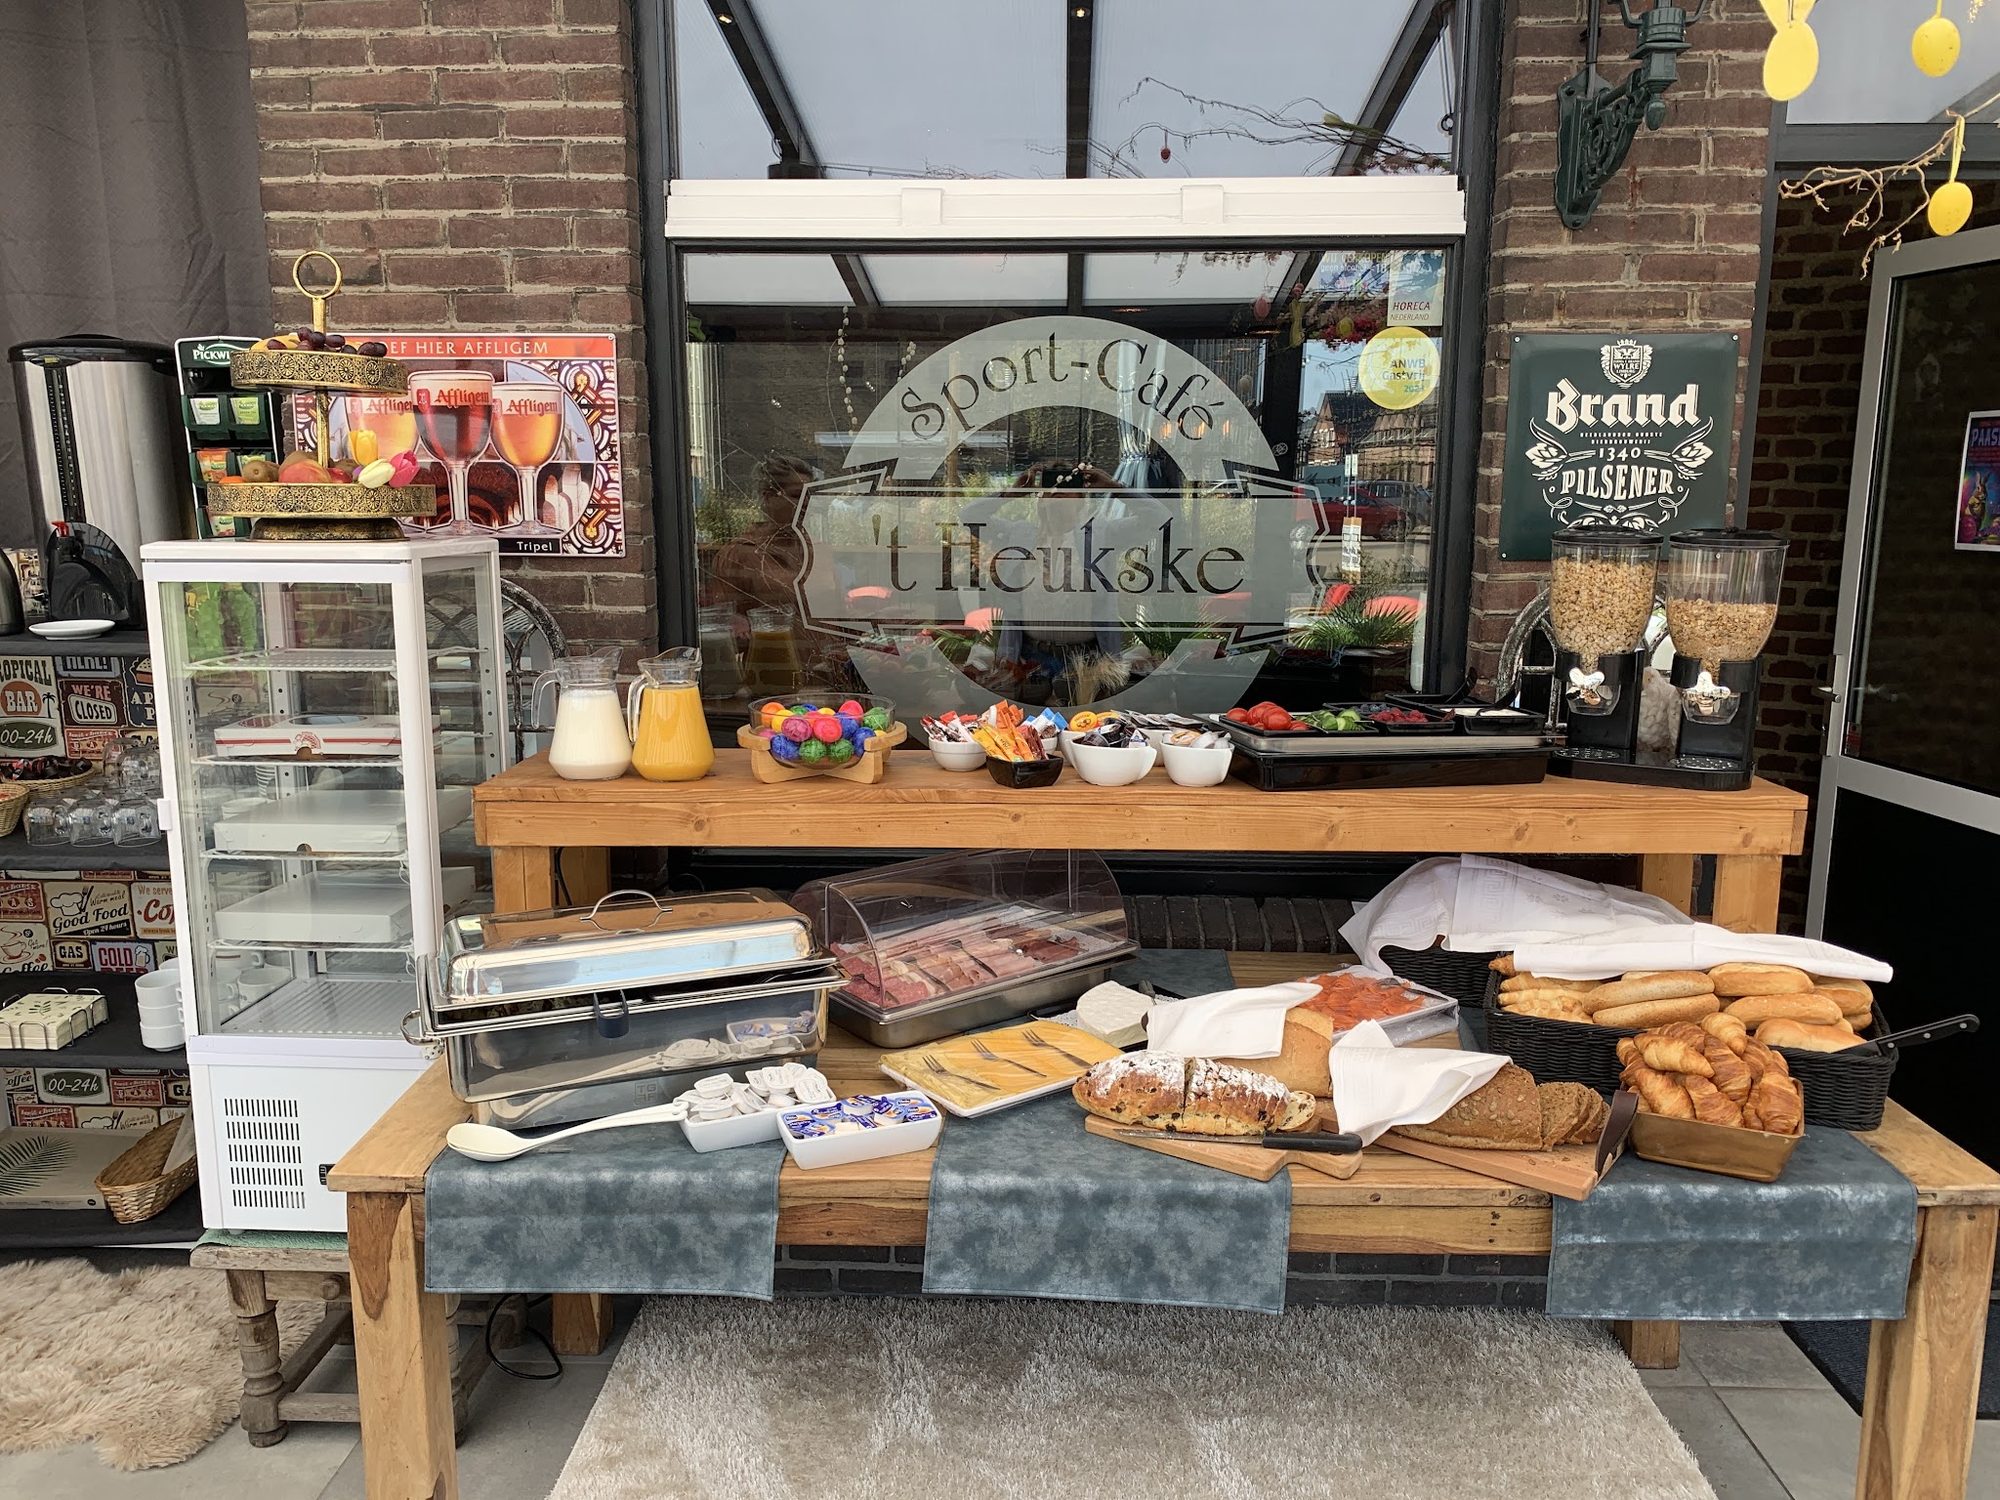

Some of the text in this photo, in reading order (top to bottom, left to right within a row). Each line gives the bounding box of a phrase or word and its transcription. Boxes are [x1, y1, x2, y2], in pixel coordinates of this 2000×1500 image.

[1392, 301, 1431, 311] HORECA
[1390, 313, 1430, 321] NEDERLAND
[415, 341, 457, 355] HIER
[463, 341, 549, 355] AFFLIGEM
[1390, 359, 1426, 369] ANWB
[899, 331, 1226, 441] Sport-Café
[434, 388, 490, 408] Affligem
[1545, 377, 1701, 434] Brand
[506, 399, 558, 417] Affligem
[1599, 447, 1641, 462] 1340
[1560, 464, 1674, 500] PILSENER
[516, 541, 553, 553] Tripel
[935, 517, 1245, 594] Heukske
[5, 690, 38, 712] BAR
[71, 684, 112, 701] WE'RE
[75, 700, 112, 720] CLOSED
[0, 727, 54, 744] 00-24h
[138, 885, 150, 895] We
[53, 903, 130, 934] Good Food
[59, 946, 83, 958] GAS
[98, 947, 133, 967] COLD
[48, 1075, 99, 1092] 00-24h
